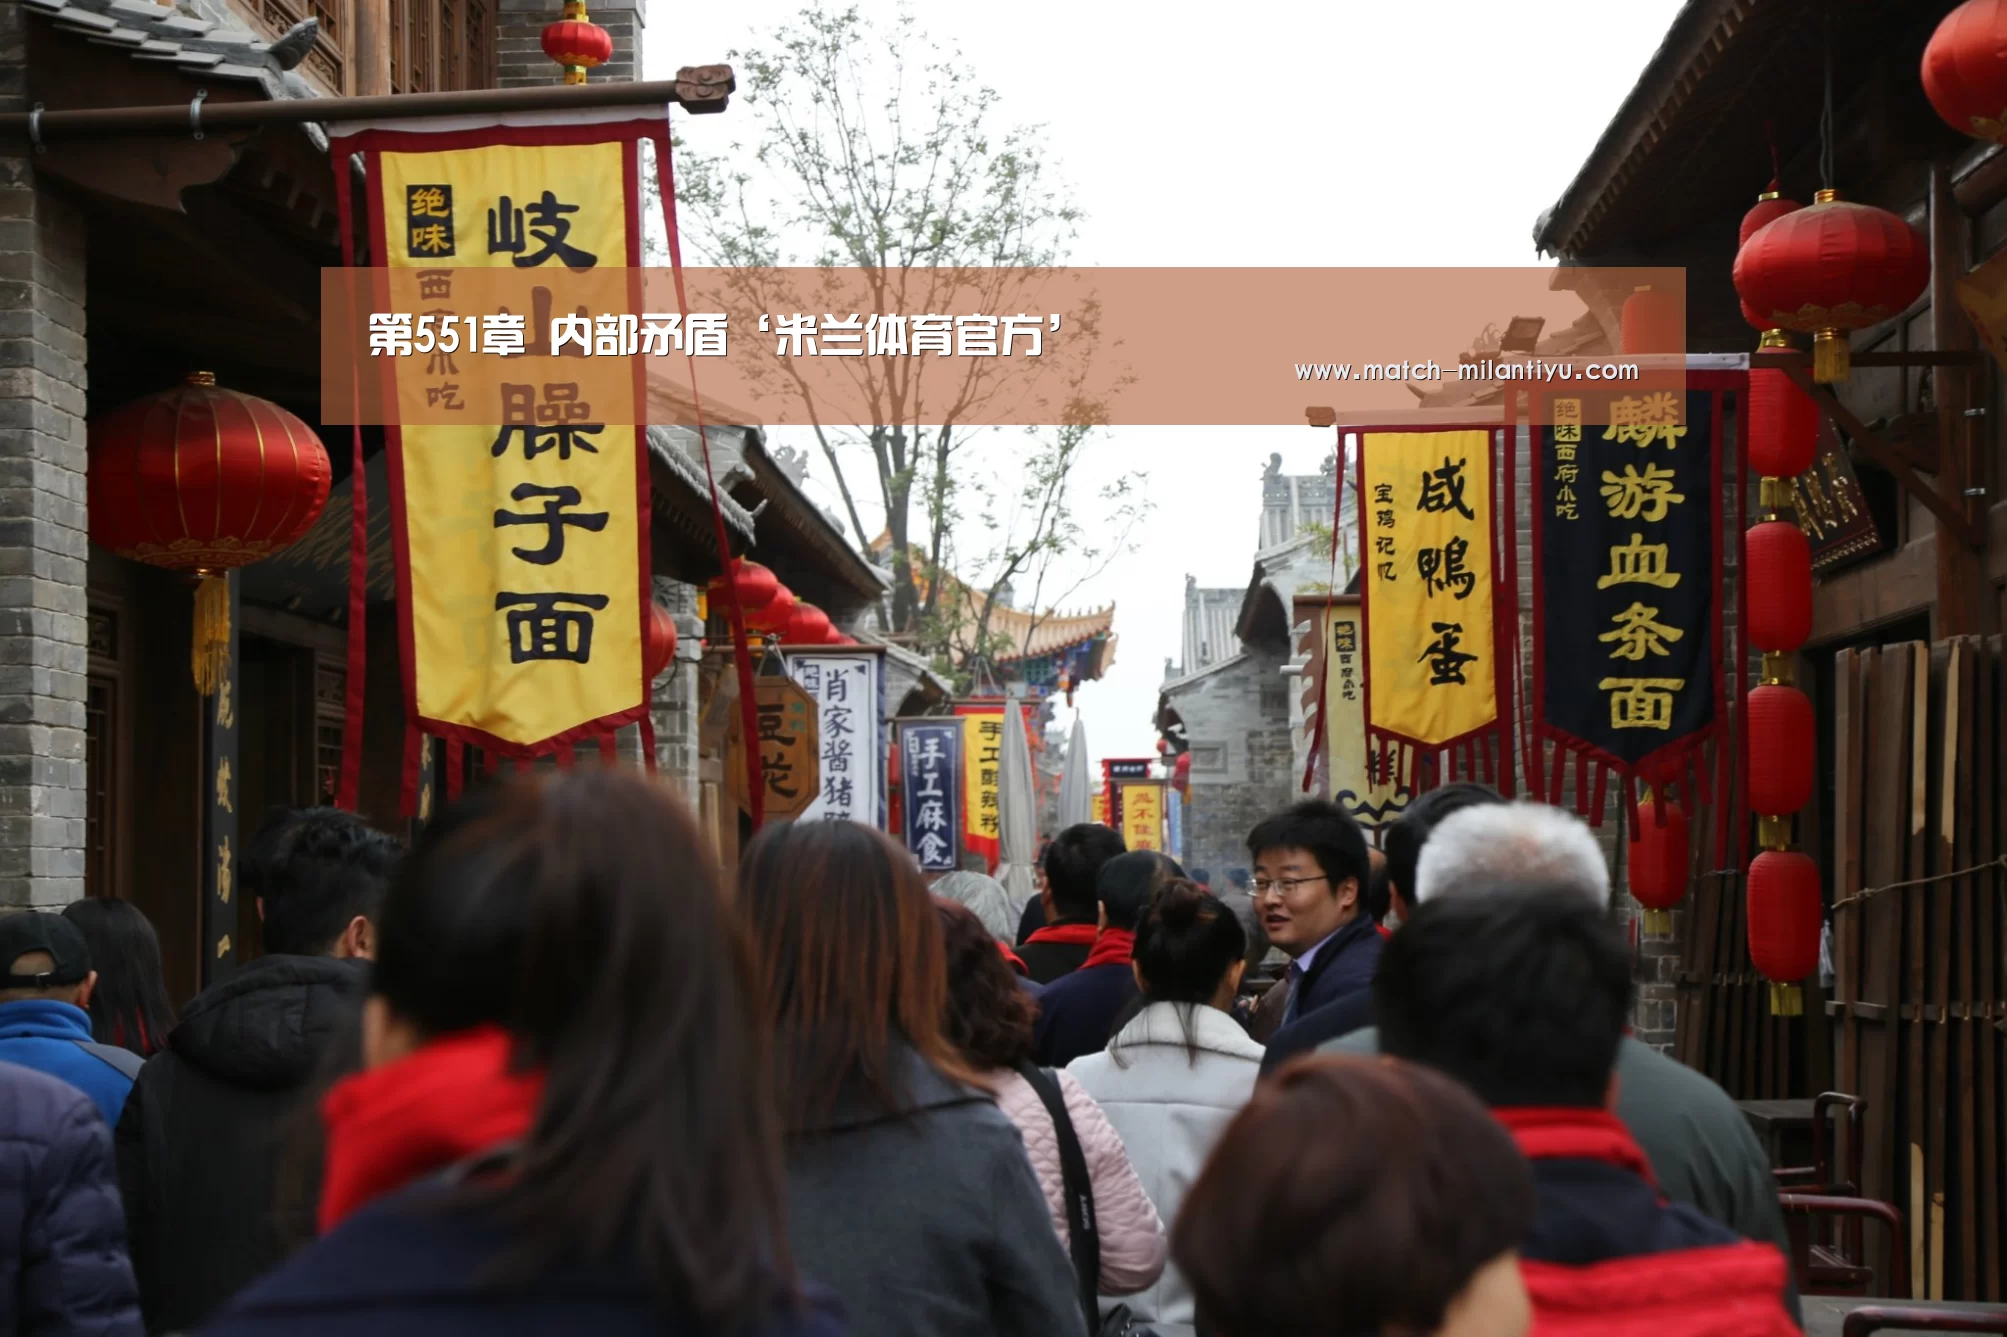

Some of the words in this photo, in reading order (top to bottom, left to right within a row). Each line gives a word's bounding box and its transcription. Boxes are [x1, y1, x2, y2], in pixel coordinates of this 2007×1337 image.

[411, 187, 451, 254] 绝味
[487, 190, 610, 665] 岐山臊子面
[1555, 400, 1579, 439] 绝味
[1554, 443, 1580, 521] 西府小吃
[1374, 483, 1397, 582] 宝鸡记忆
[1597, 391, 1688, 731] 麟游血条面
[756, 703, 798, 798] 豆花
[915, 737, 948, 865] 手工麻食
